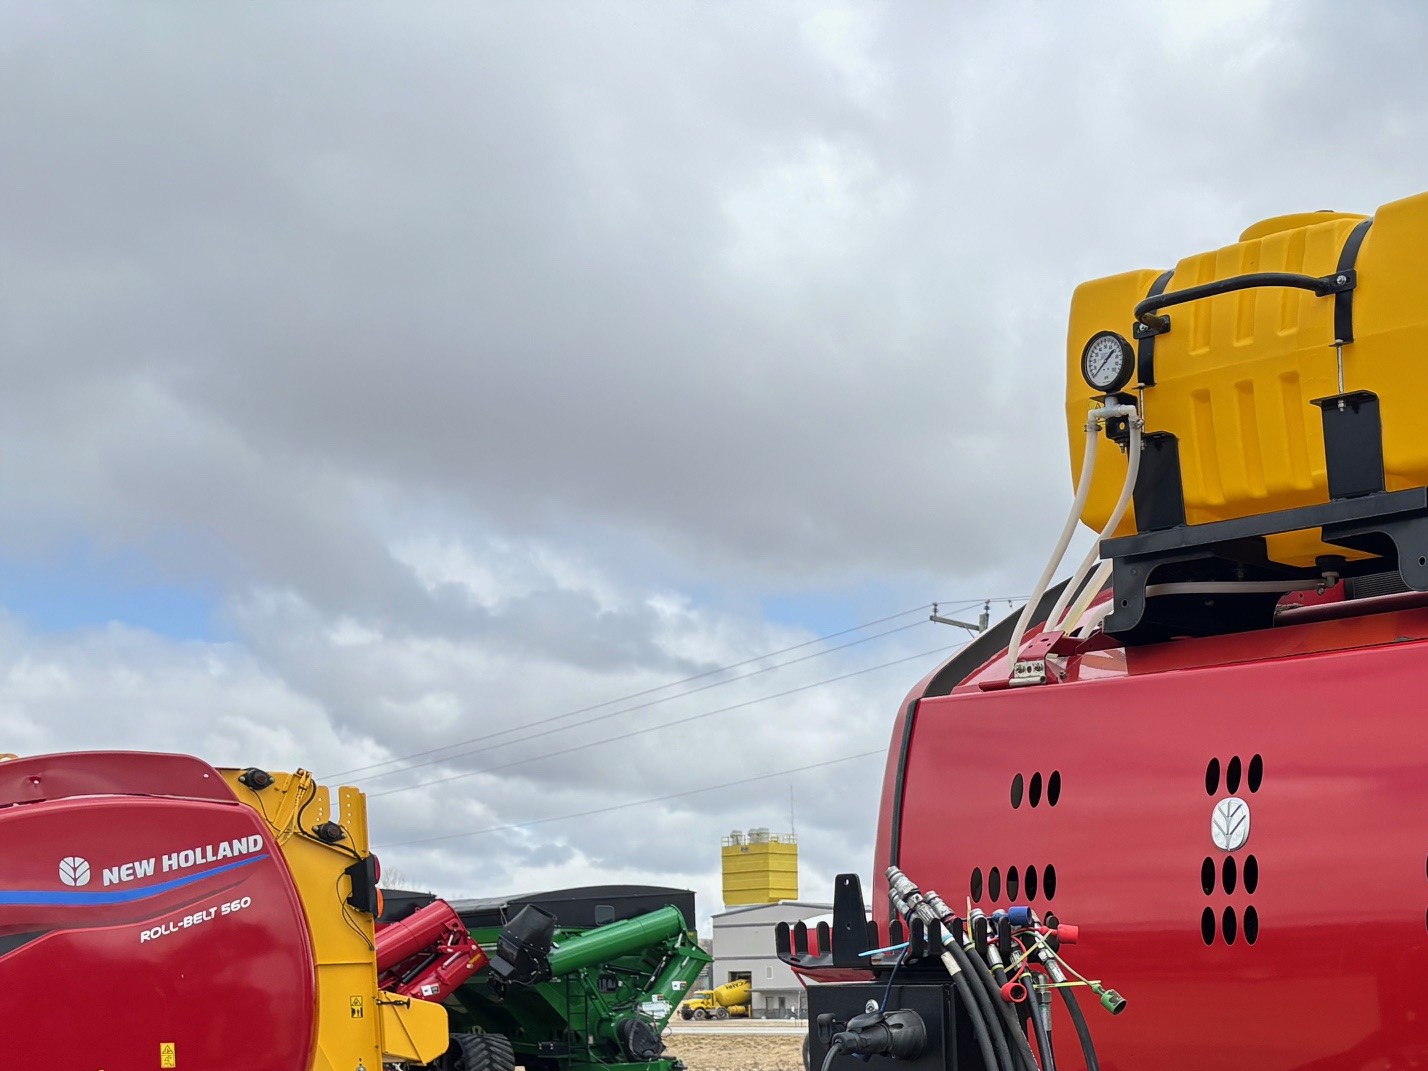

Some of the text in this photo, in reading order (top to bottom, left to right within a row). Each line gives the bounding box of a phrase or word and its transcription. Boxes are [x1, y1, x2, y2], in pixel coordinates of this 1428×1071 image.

[102, 834, 264, 887] NEW HOLLAND
[140, 896, 252, 943] ROLL-BELT 560
